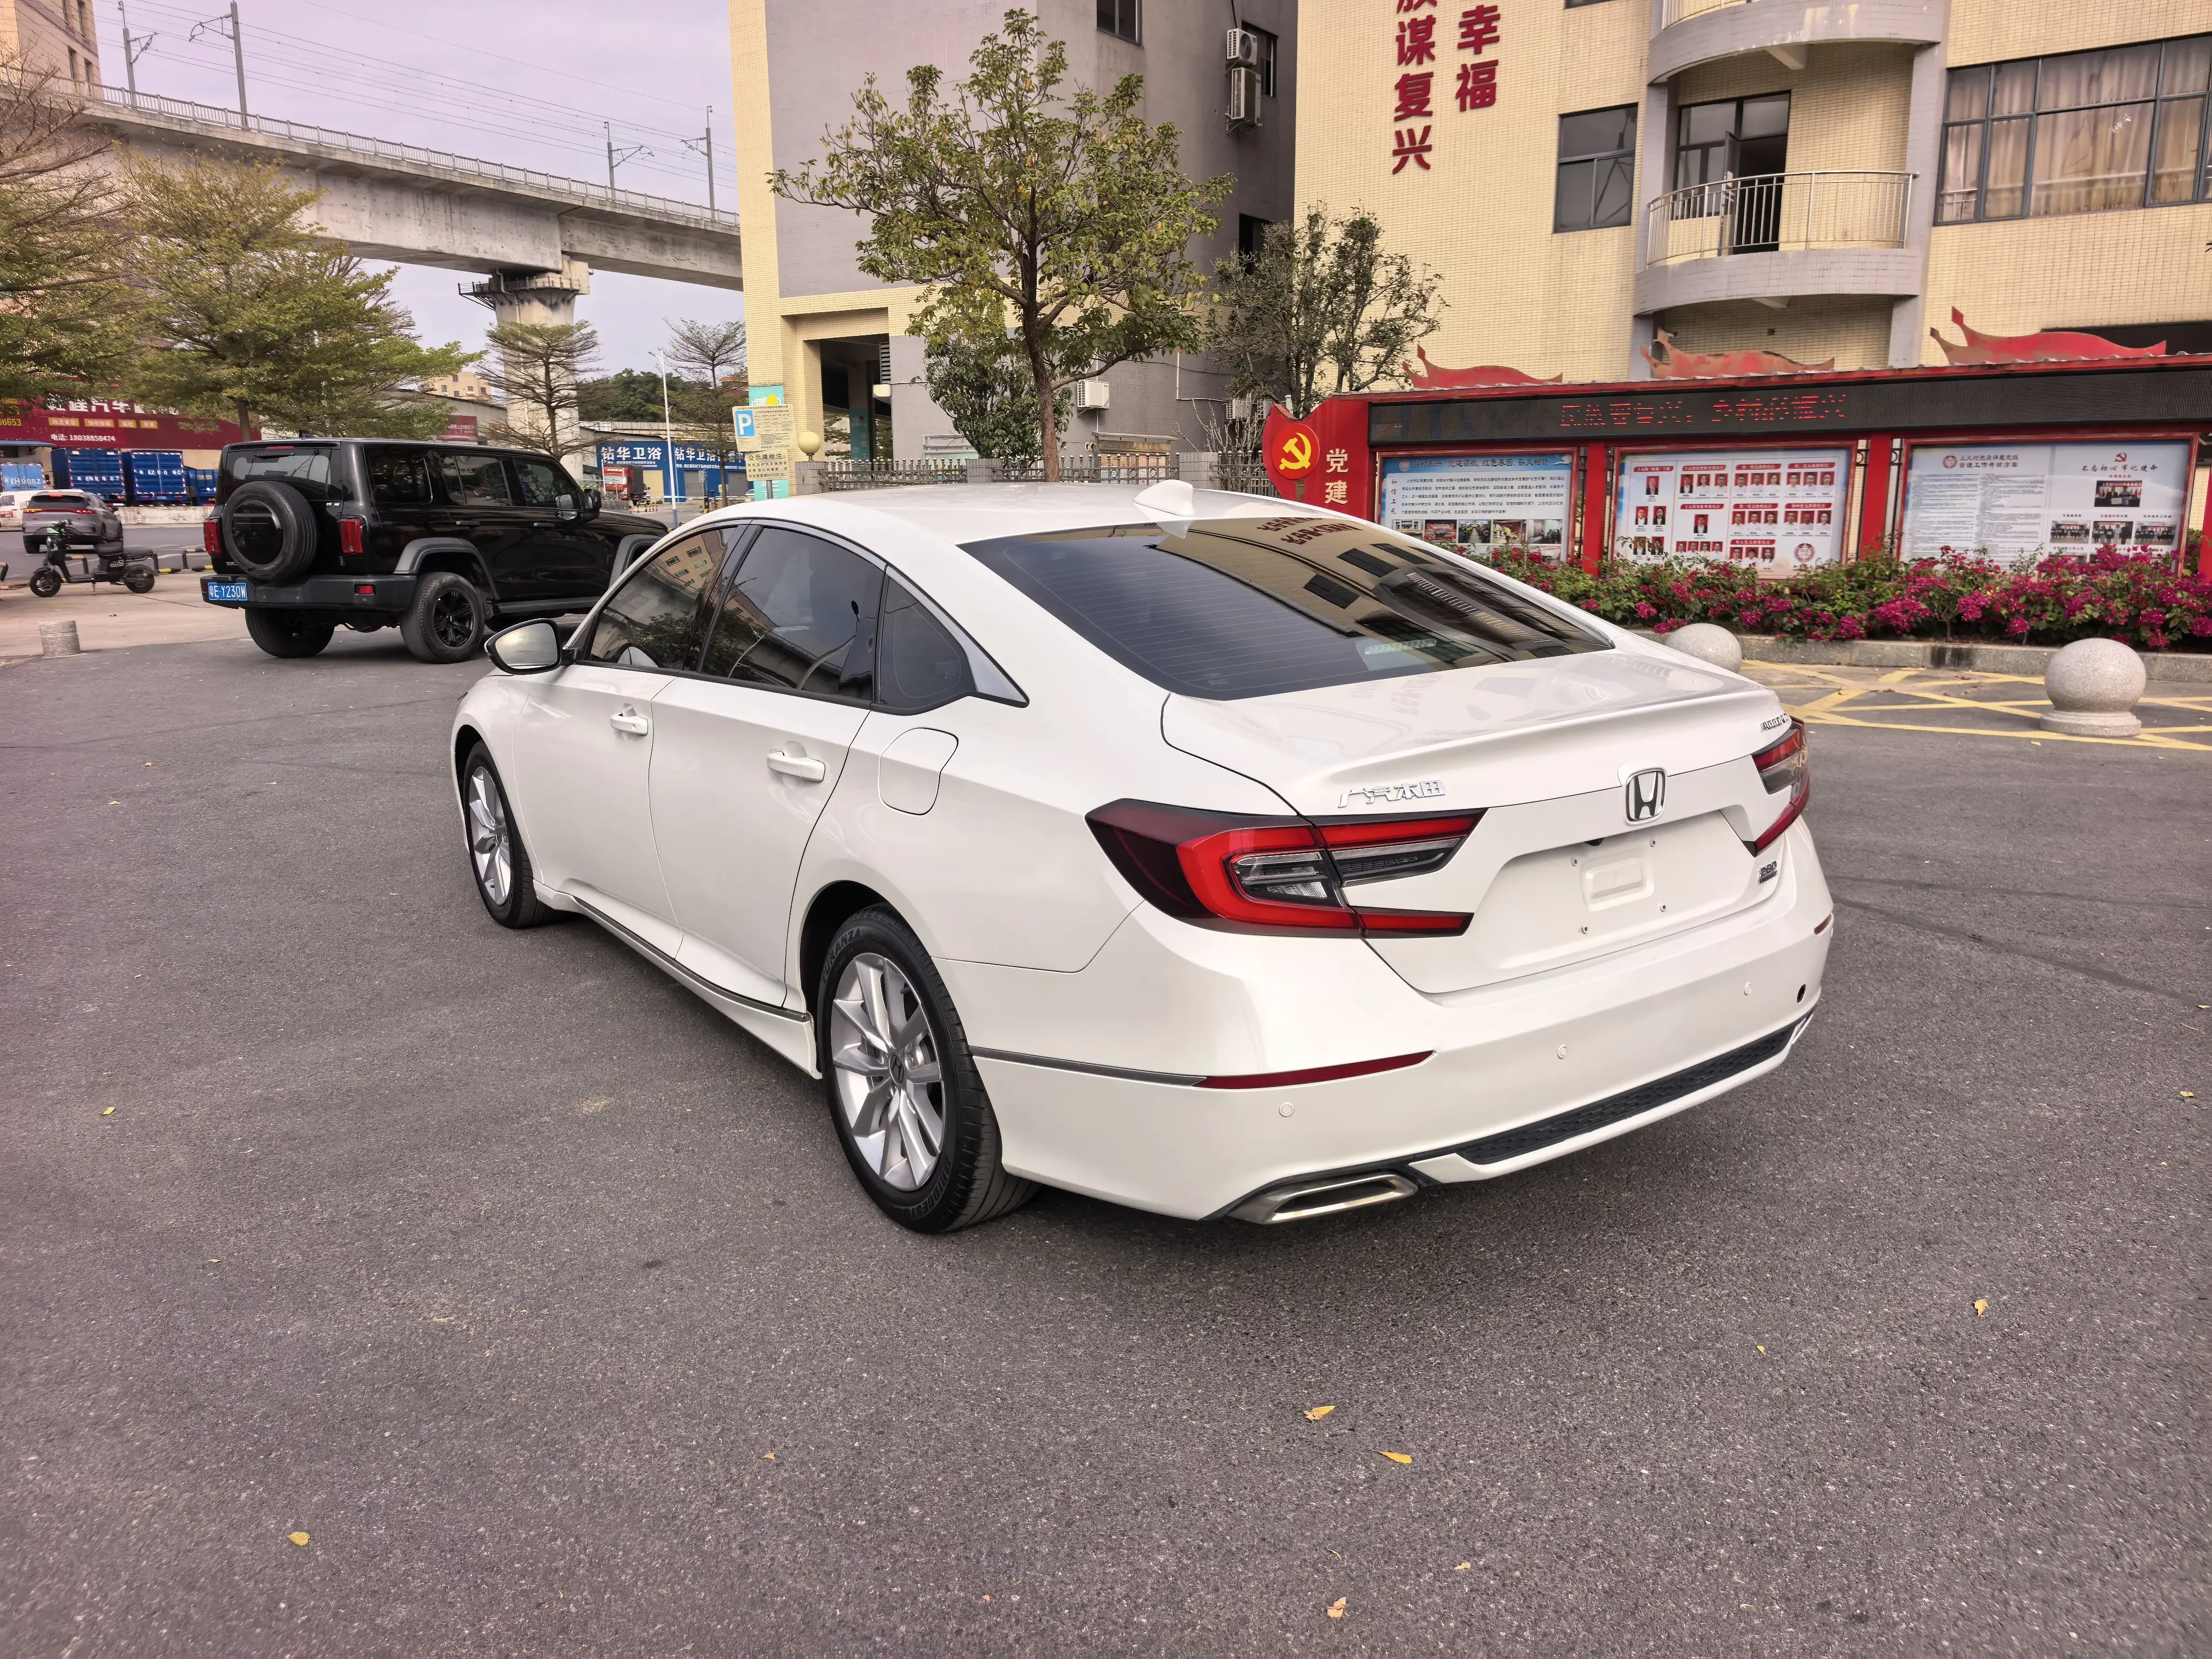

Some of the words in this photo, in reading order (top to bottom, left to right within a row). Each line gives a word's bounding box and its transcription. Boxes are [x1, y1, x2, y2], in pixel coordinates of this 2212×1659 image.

[1455, 4, 1501, 112] 幸福
[601, 447, 662, 460] 钻华卫浴
[1325, 448, 1348, 504] 党建
[1337, 779, 1446, 808] 广汽本田
